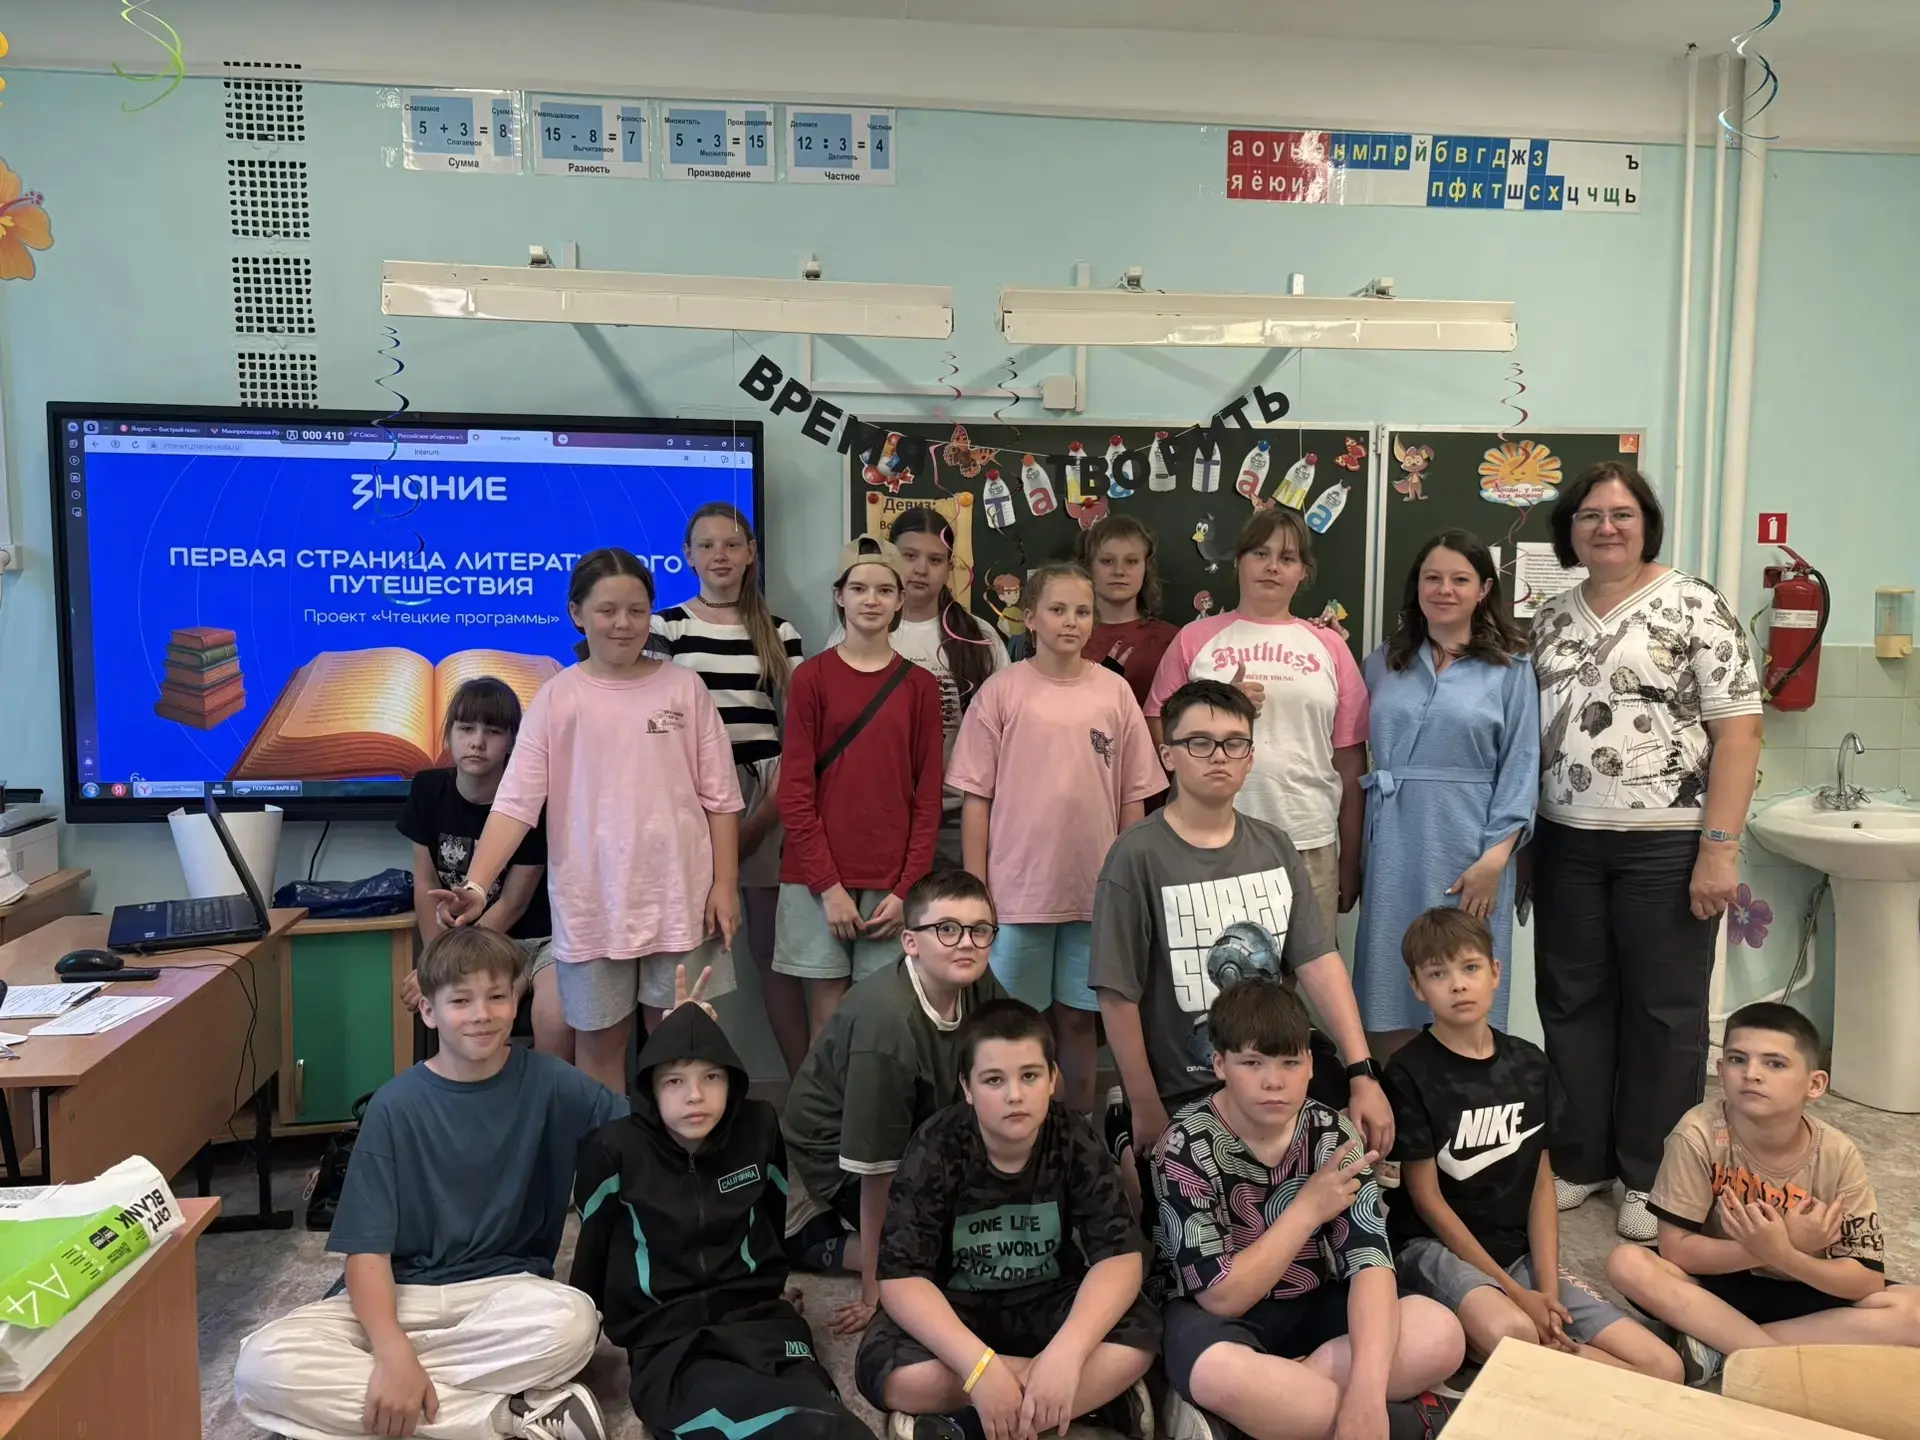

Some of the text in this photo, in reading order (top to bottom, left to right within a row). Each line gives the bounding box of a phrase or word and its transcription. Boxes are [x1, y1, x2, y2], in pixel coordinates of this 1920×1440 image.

[404, 104, 440, 112] Слагаемое
[616, 114, 646, 123] Разность
[664, 117, 701, 125] Множитель
[727, 118, 773, 127] Произведение
[419, 121, 427, 134] 5
[460, 122, 468, 136] 3
[500, 124, 507, 138] 8
[866, 123, 892, 131] Частное
[446, 138, 482, 147] Слагаемое
[545, 126, 561, 141] 15
[589, 129, 598, 143] 8
[628, 131, 636, 144] 7
[676, 133, 684, 147] 5
[713, 134, 722, 148] 3
[749, 135, 764, 148] 15
[573, 144, 614, 153] Вычитаемое
[797, 136, 812, 150] 12
[839, 138, 847, 151] 3
[876, 139, 884, 152] 4
[700, 149, 736, 157] Множитель
[448, 157, 480, 169] Сумма
[568, 163, 611, 174] Разность
[687, 168, 751, 179] Произведение
[824, 171, 860, 181] Частное
[739, 354, 1290, 497] ВРЕМЯ ТВОРИТЬ
[302, 430, 345, 441] 000 410
[414, 448, 440, 456] Interum
[883, 498, 937, 513] Девиз:
[169, 547, 286, 568] ПЕРВАЯ
[296, 549, 446, 572] СТРАНИЦА
[330, 575, 533, 596] ПУТЕШЕСТВИЯ
[304, 609, 560, 627] Проект «Чтецкие программы»
[1211, 641, 1321, 676] Ruthless
[1454, 1101, 1525, 1150] NIKE
[721, 1170, 757, 1190] CALIFORNIA
[113, 1188, 165, 1230] BLANK
[147, 1206, 172, 1233] art
[968, 1215, 1041, 1235] ONE LIFE
[957, 1238, 1056, 1261] ONE WORLD
